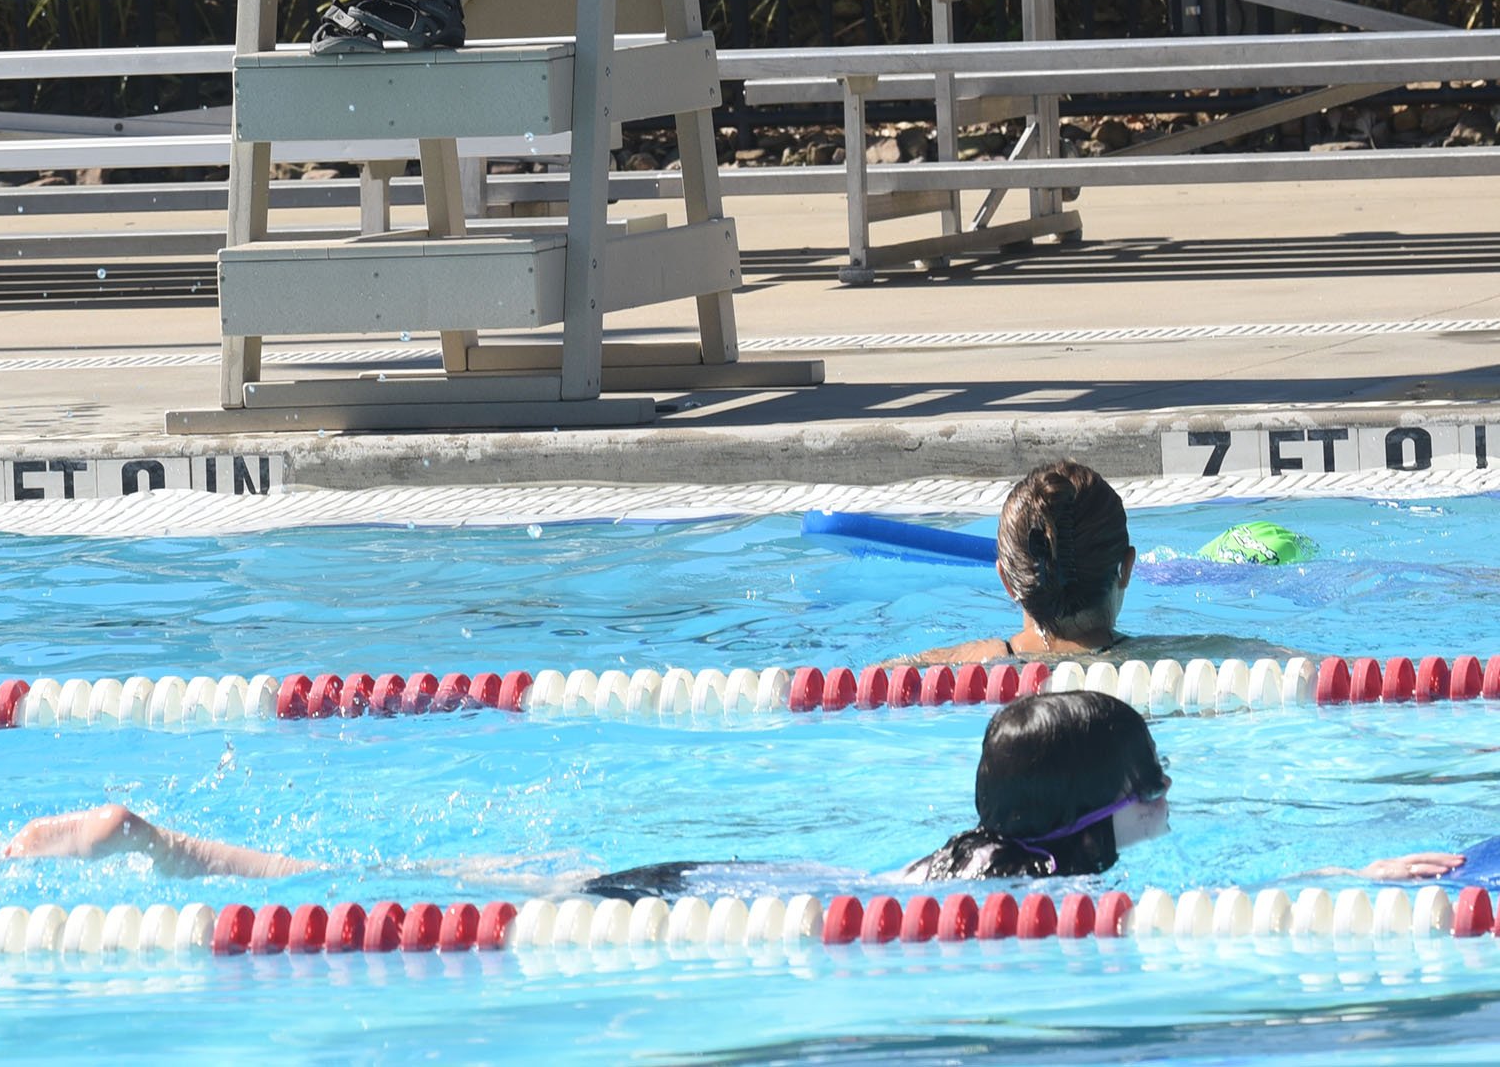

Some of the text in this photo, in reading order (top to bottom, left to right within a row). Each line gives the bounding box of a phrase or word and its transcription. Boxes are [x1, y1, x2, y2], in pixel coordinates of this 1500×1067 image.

[1188, 431, 1231, 476] 7
[1269, 429, 1348, 477] FT
[14, 459, 87, 500] FT
[205, 455, 270, 495] IN
